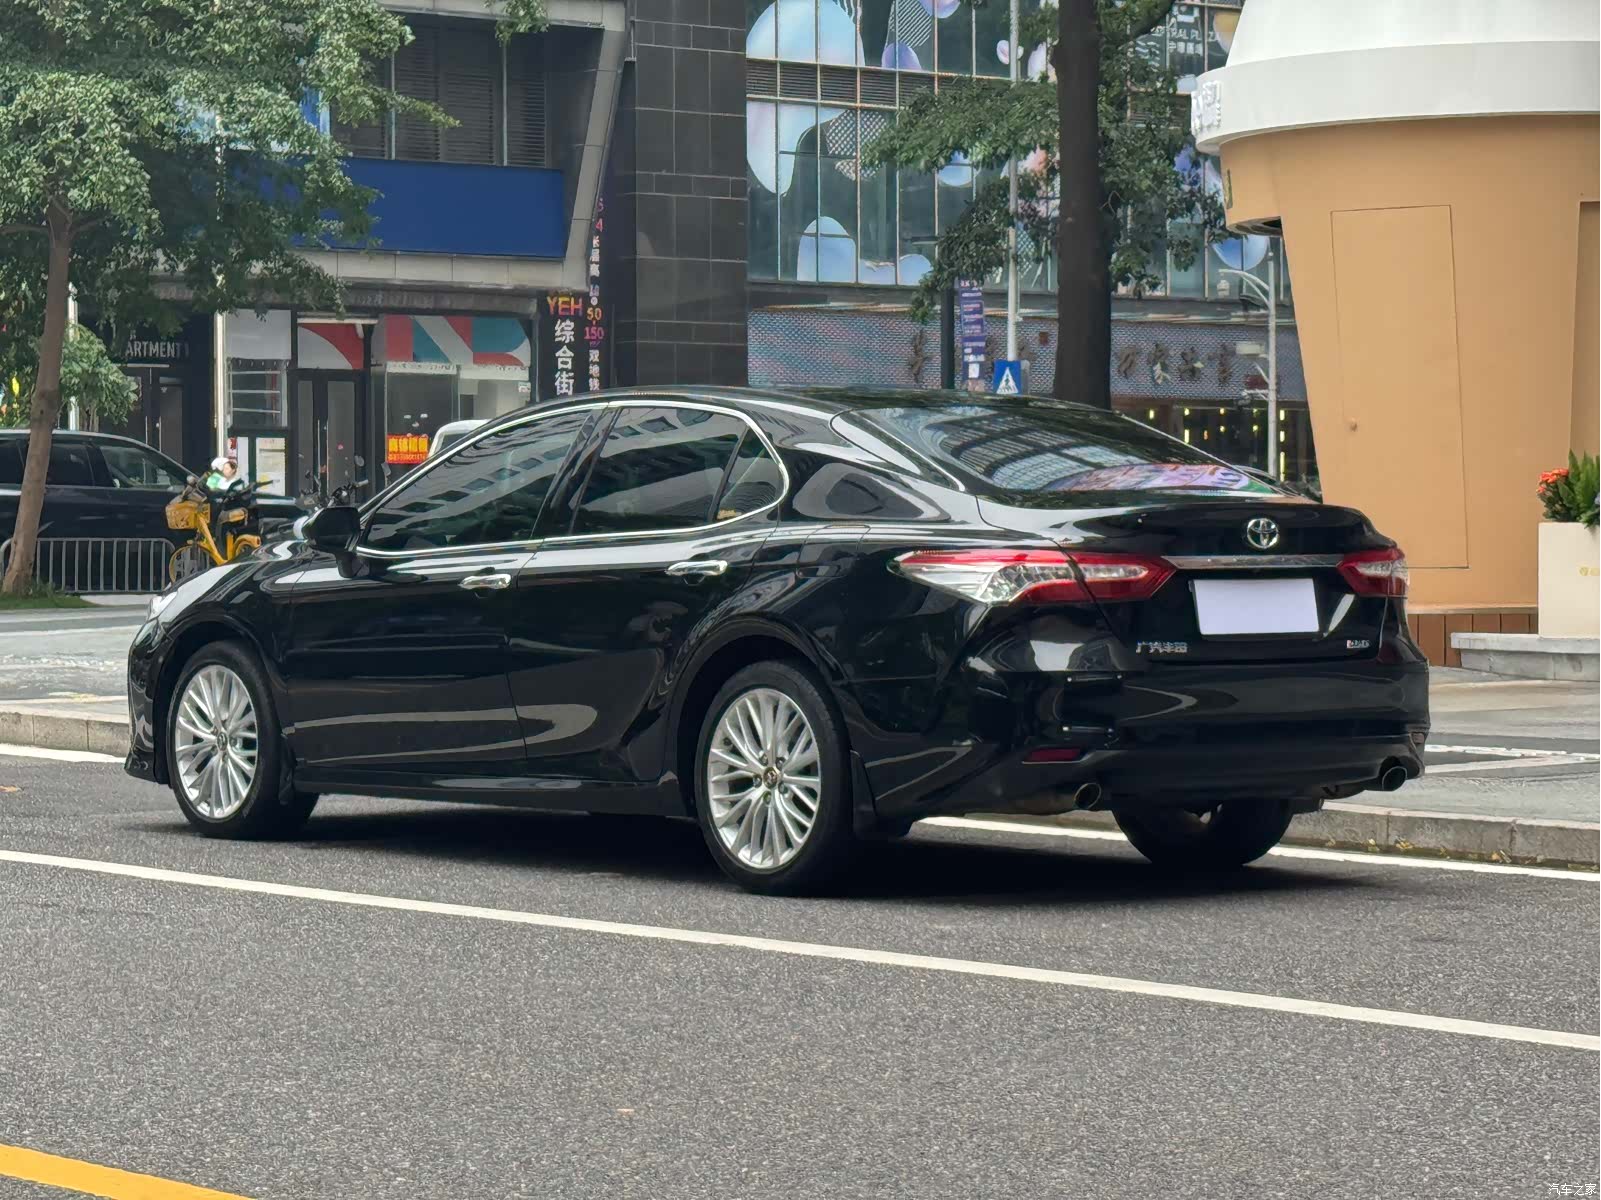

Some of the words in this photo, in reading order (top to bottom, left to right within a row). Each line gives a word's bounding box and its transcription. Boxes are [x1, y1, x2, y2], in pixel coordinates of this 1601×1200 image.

[547, 296, 583, 317] YEH
[125, 340, 189, 358] ARTMENT
[554, 318, 575, 396] 综合街
